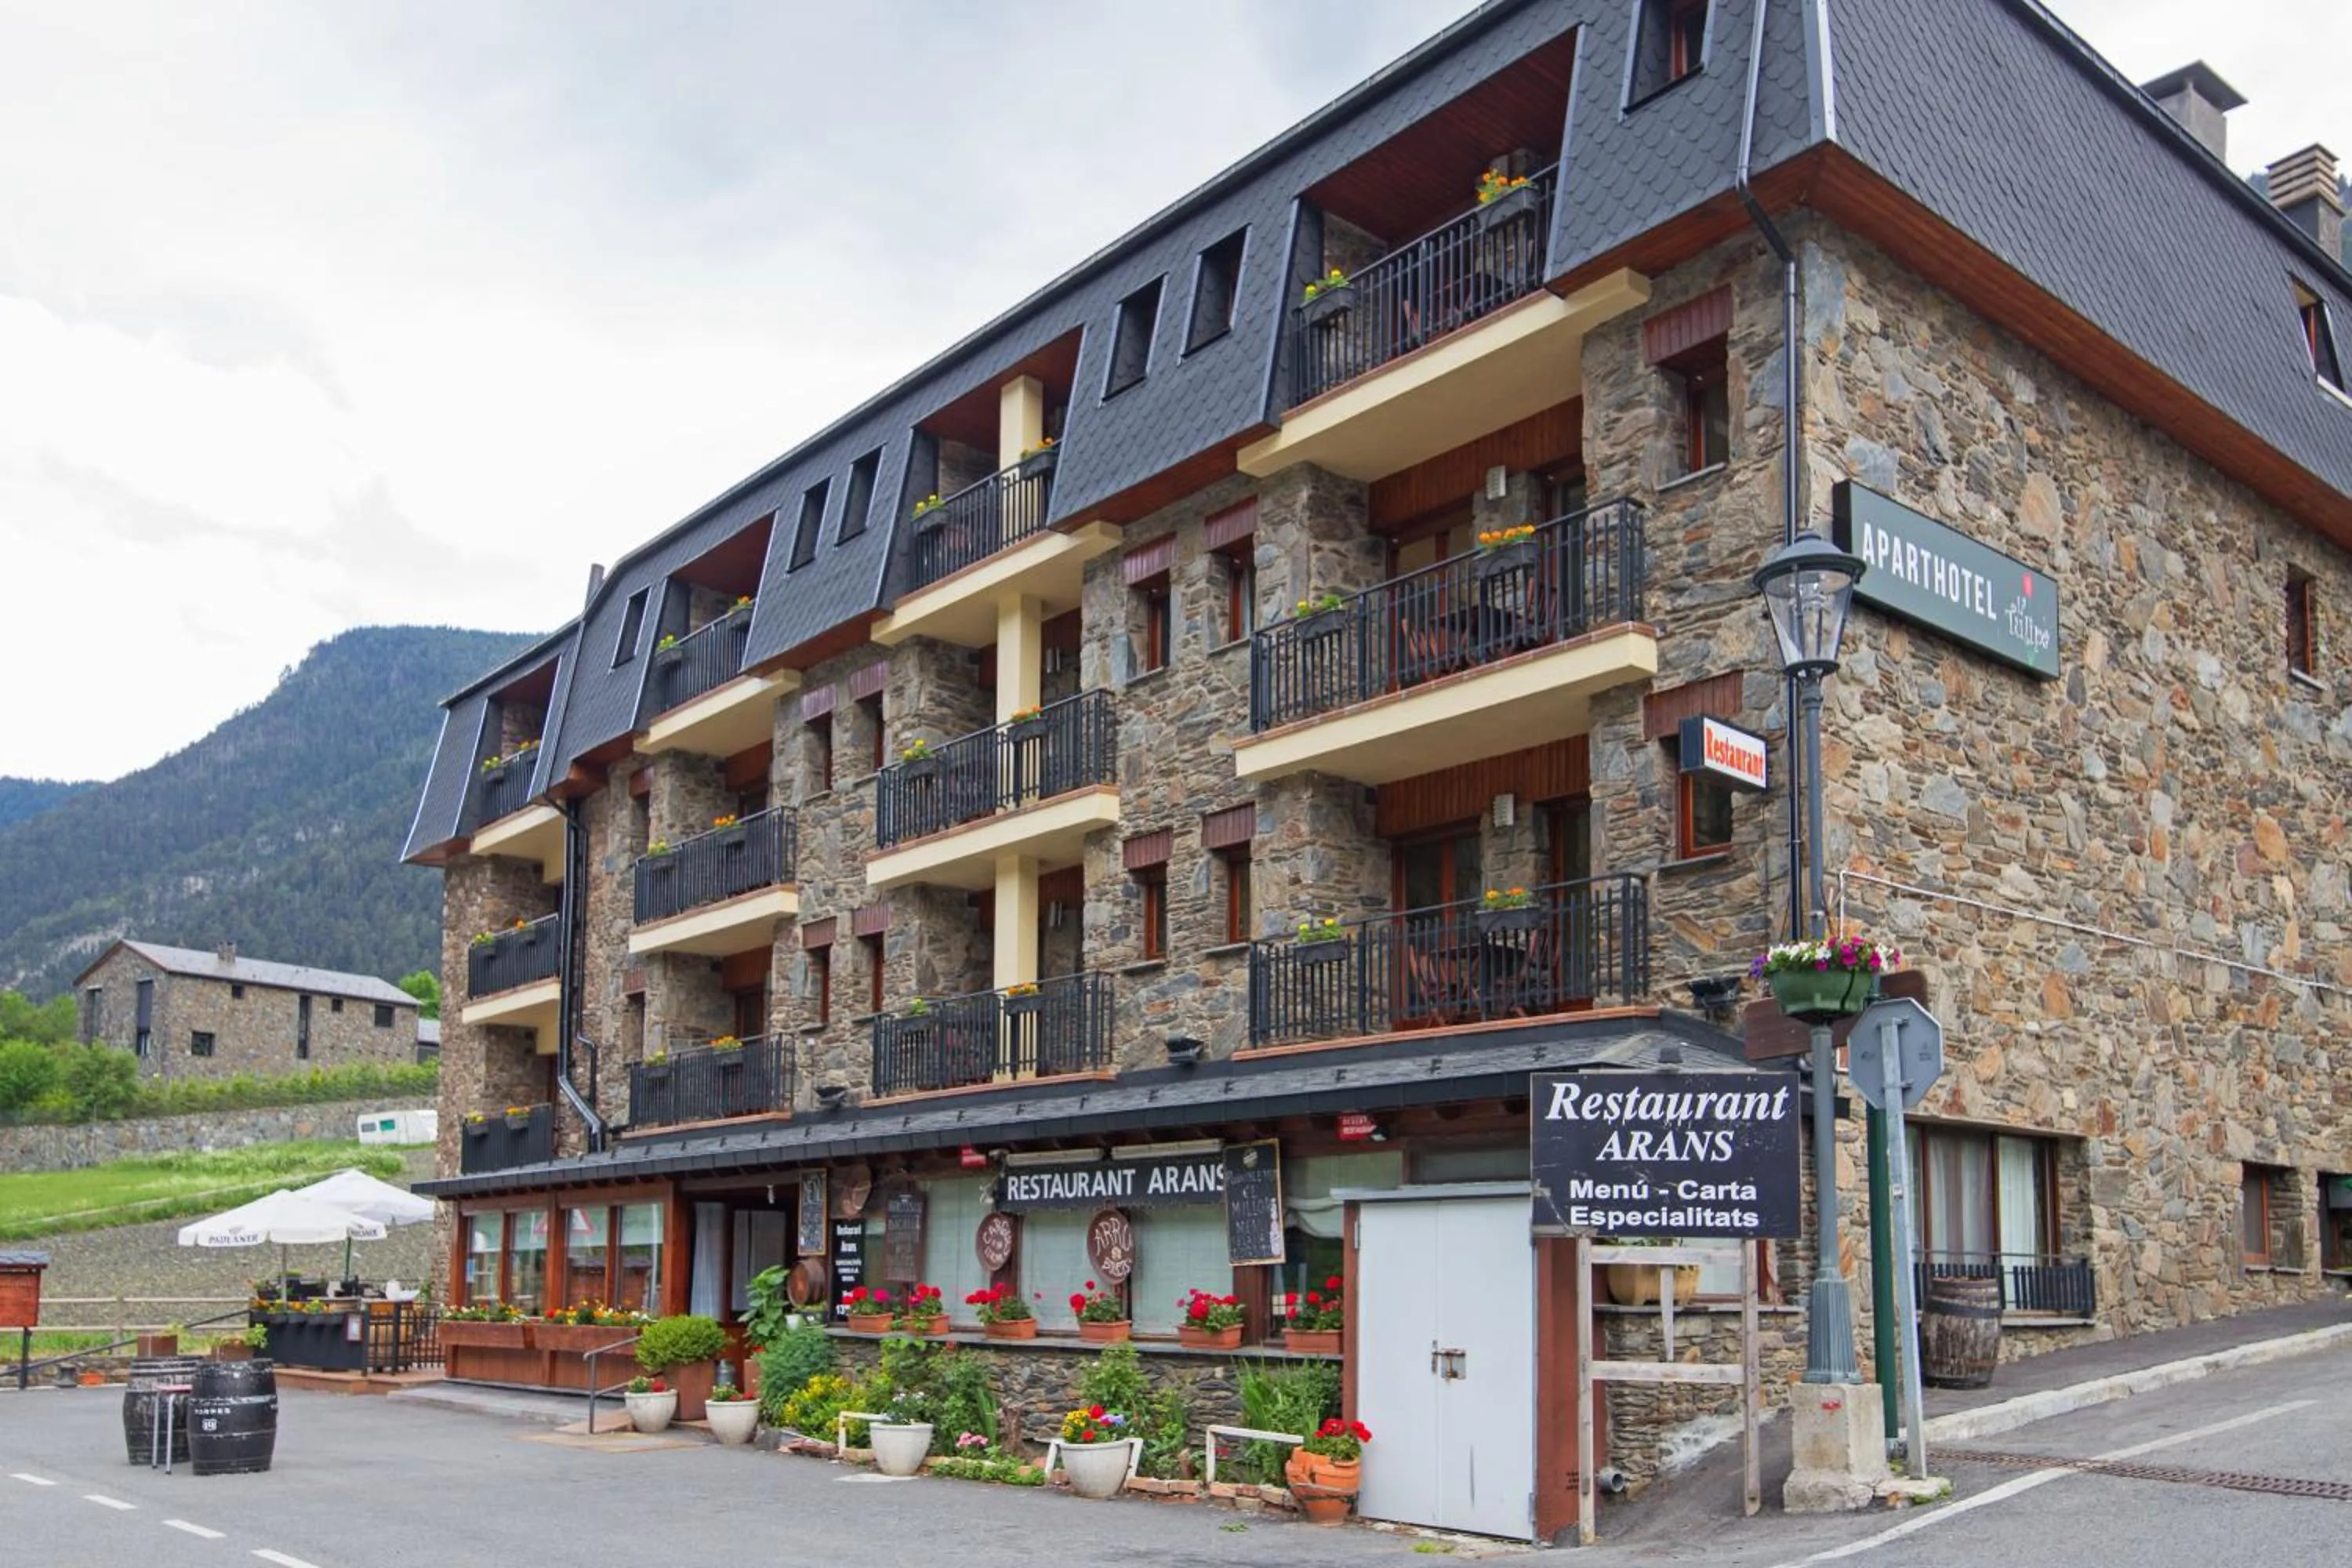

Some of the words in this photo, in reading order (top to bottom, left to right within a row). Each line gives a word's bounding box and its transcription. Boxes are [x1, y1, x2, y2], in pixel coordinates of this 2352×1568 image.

[1862, 522, 1997, 620] APARTHOTEL
[1705, 727, 1764, 779] Restaurant
[1544, 1082, 1790, 1122] Restaurant
[1595, 1130, 1735, 1162] ARANS
[1007, 1168, 1136, 1201] RESTAURANT
[1147, 1163, 1225, 1195] ARANS
[1570, 1178, 1649, 1200] Menú
[1676, 1179, 1758, 1201] Carta
[1570, 1206, 1760, 1230] Especialitats
